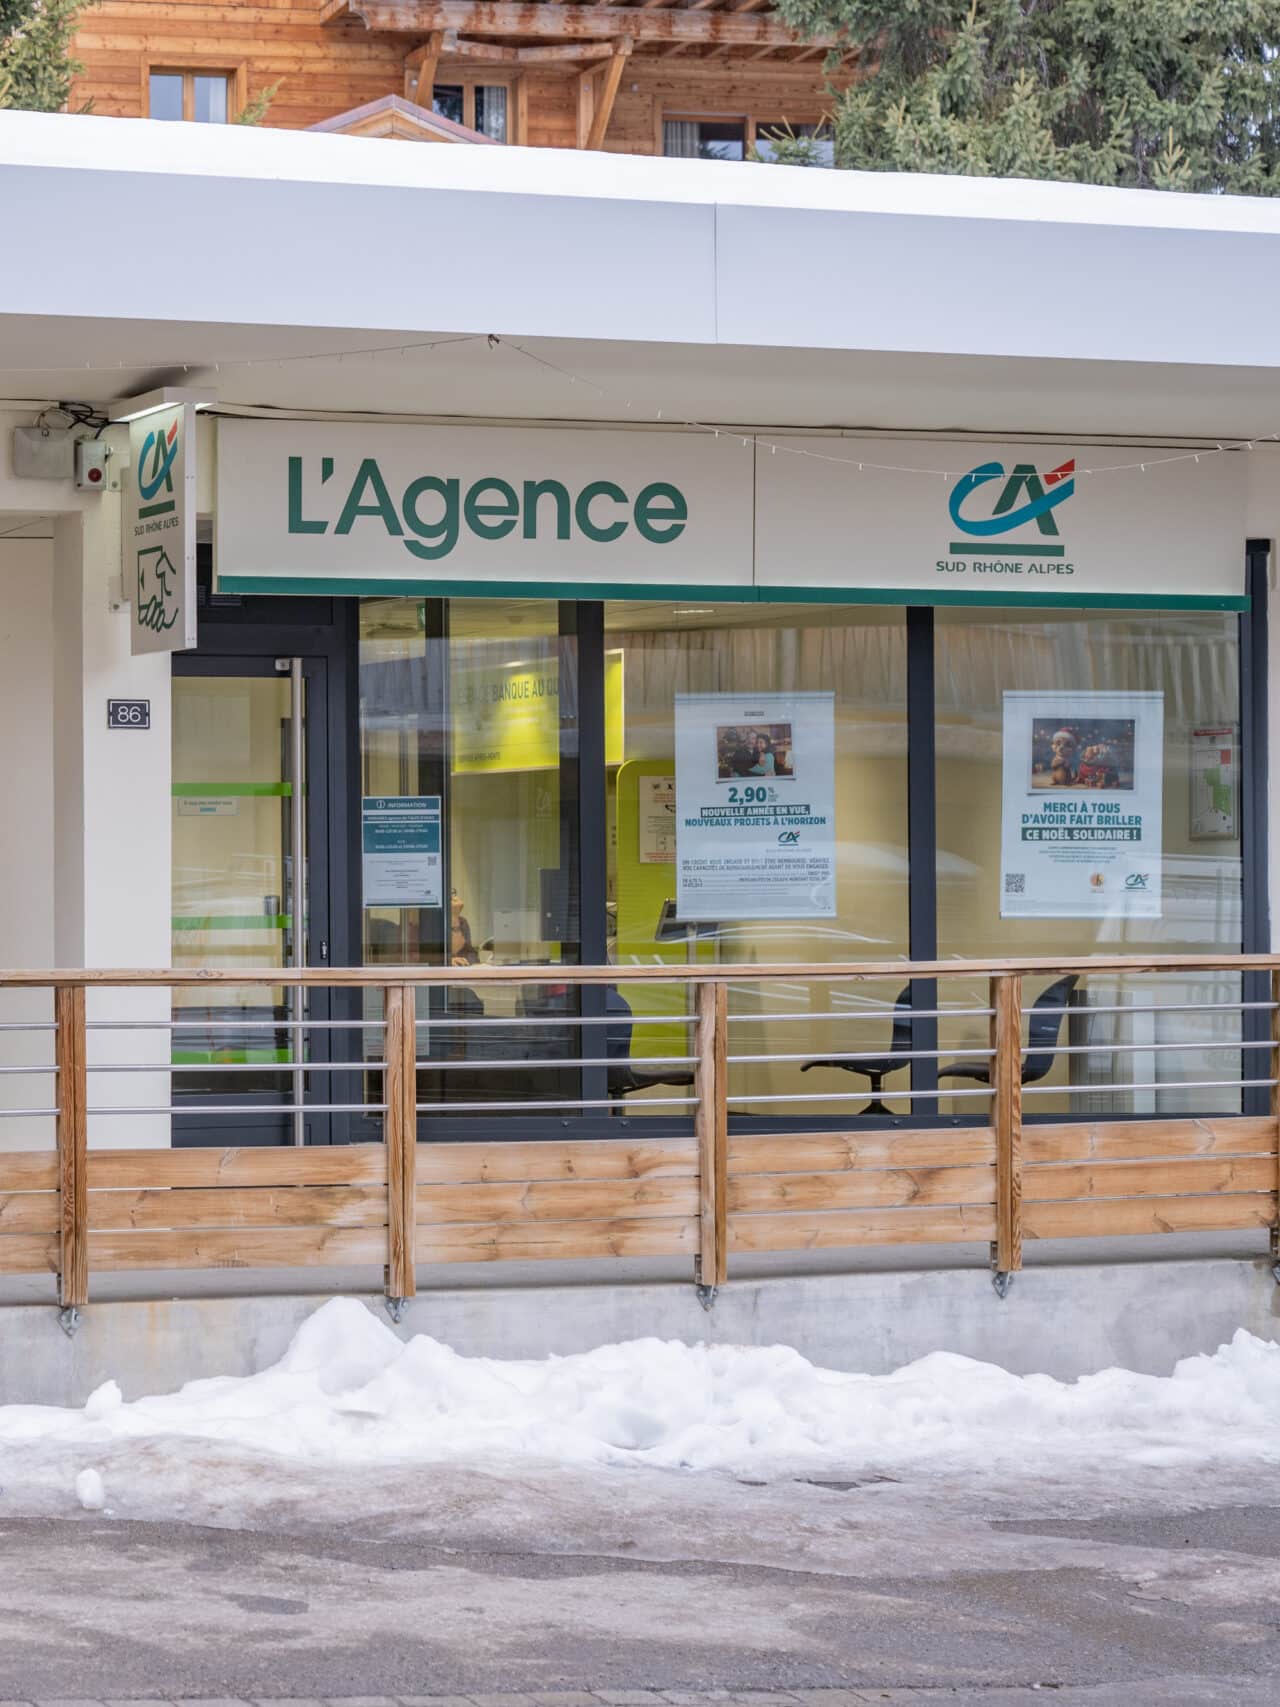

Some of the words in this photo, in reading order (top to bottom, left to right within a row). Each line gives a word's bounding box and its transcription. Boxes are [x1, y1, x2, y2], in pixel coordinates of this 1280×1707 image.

[288, 456, 688, 560] L'Agence
[936, 560, 967, 573] SUD
[972, 560, 1023, 574] RHÔNE
[1027, 563, 1075, 575] ALPES
[117, 705, 141, 723] 86
[728, 787, 767, 805] 2,90
[701, 807, 745, 817] NOUVELLE
[746, 805, 775, 816] ANNÉE
[776, 806, 788, 815] EN
[1043, 802, 1077, 813] MERCI
[1080, 800, 1088, 813] À
[1091, 803, 1120, 814] TOUS
[685, 818, 732, 827] NOUVEAUX
[734, 817, 771, 827] PROJETS
[772, 816, 780, 826] À
[781, 816, 826, 826] L'HORIZON
[1022, 814, 1067, 825] D'AVOIR
[1069, 814, 1094, 825] FAIT
[1096, 815, 1142, 826] BRILLER
[1026, 829, 1039, 840] CE
[1041, 828, 1070, 840] NOËL
[1073, 829, 1130, 840] SOLIDAIRE
